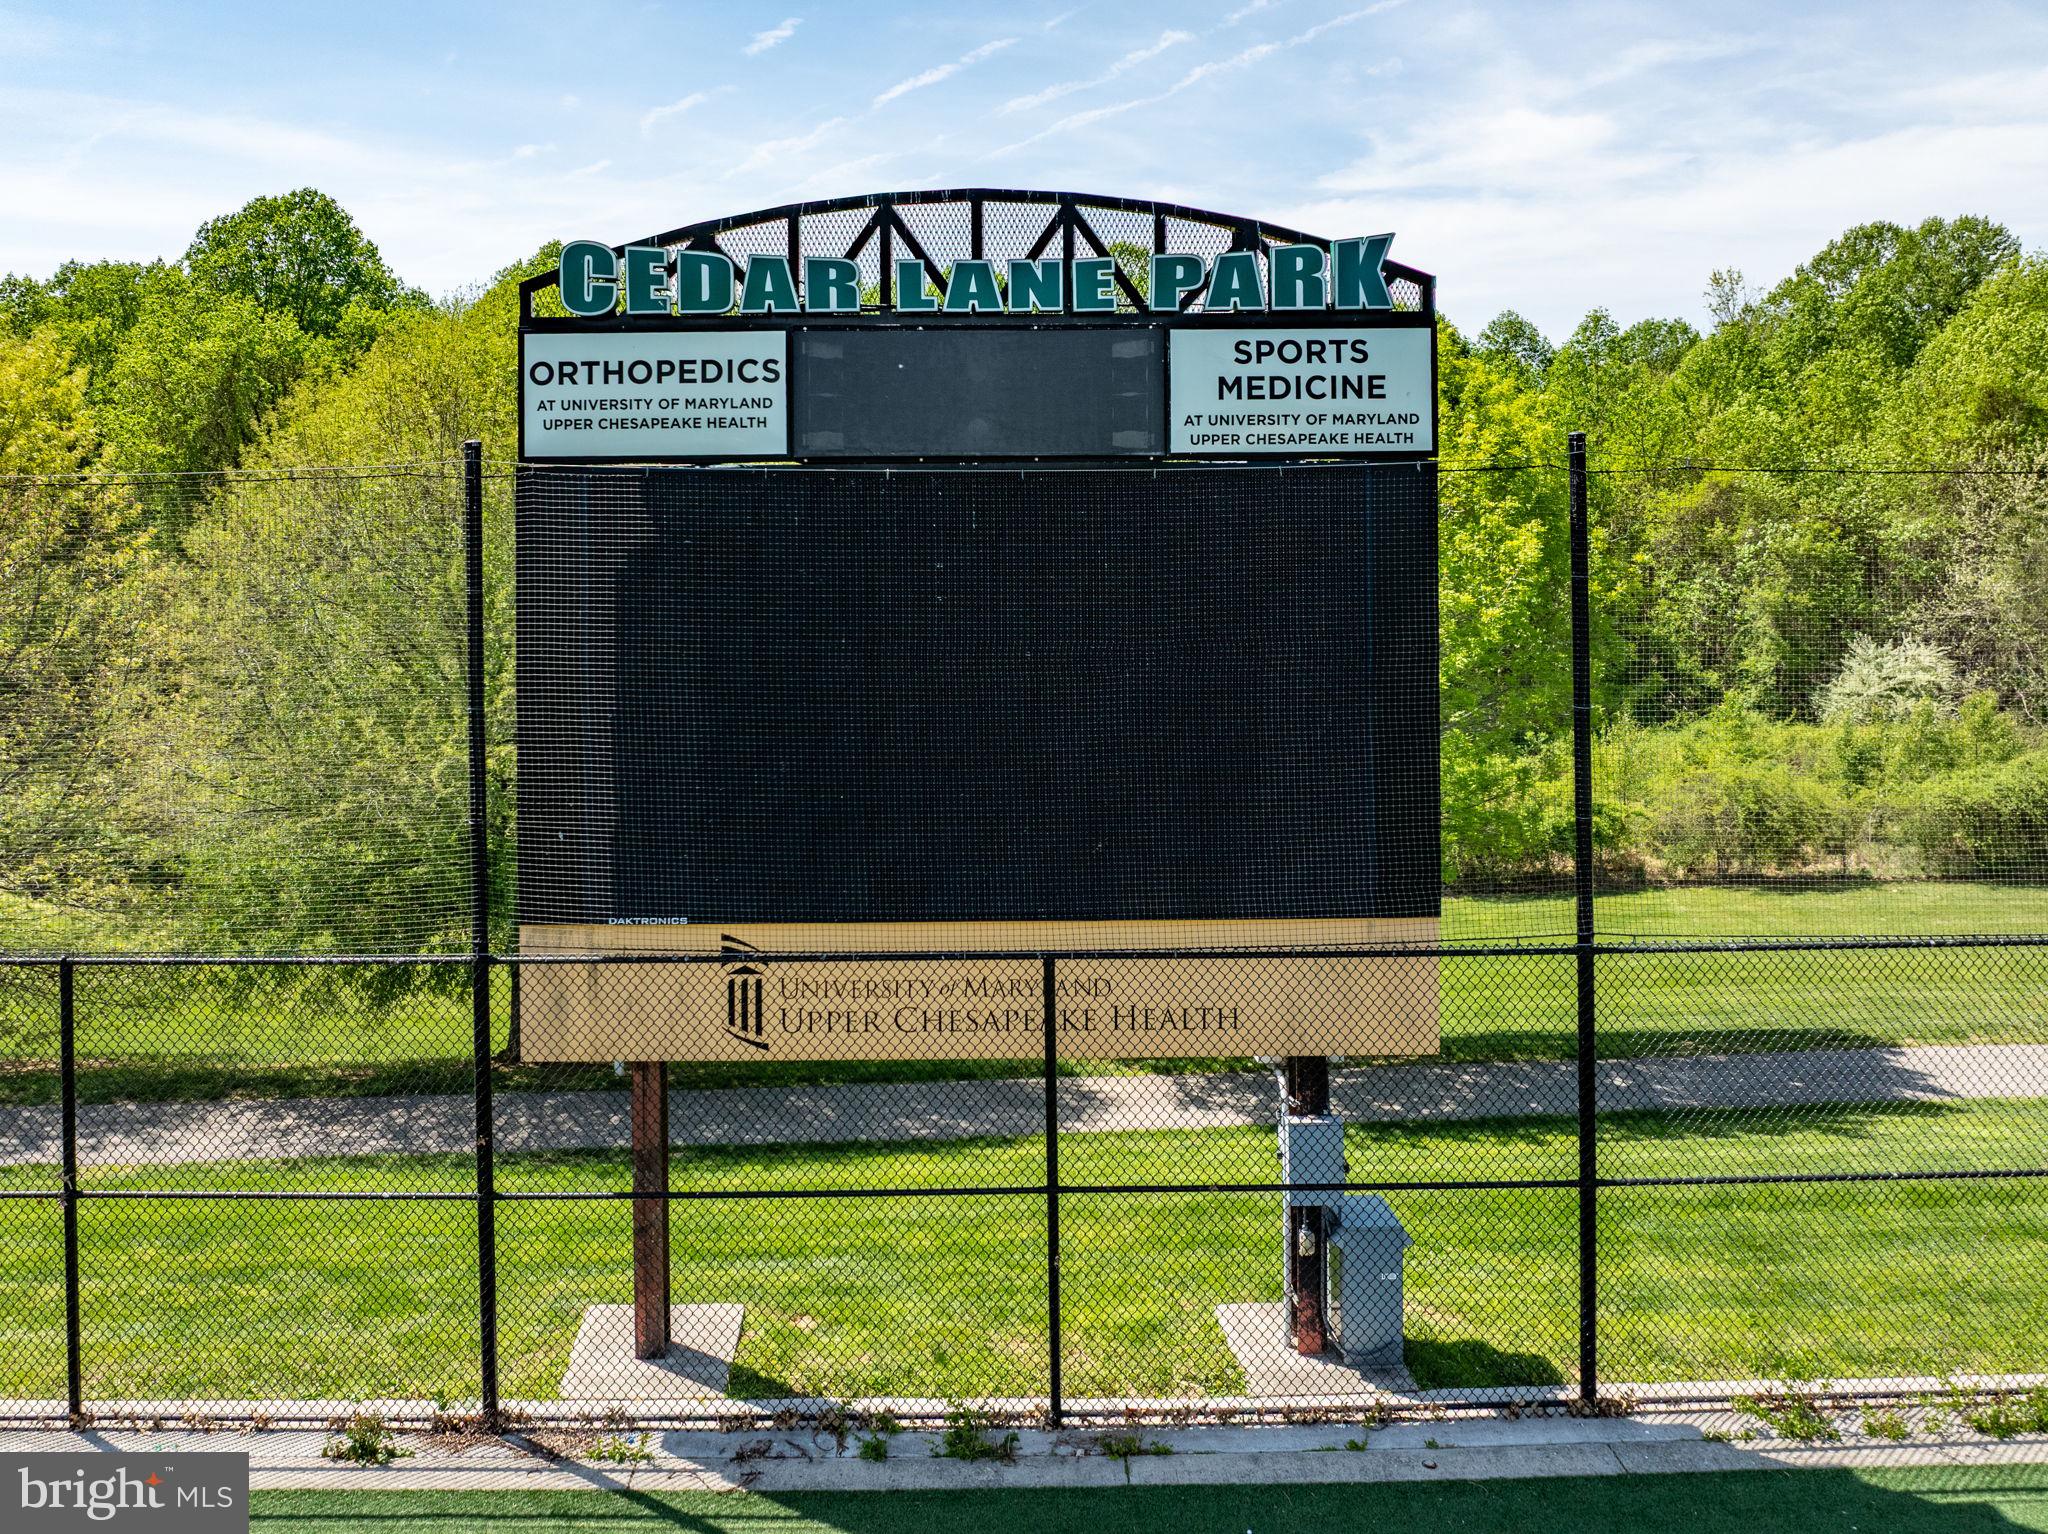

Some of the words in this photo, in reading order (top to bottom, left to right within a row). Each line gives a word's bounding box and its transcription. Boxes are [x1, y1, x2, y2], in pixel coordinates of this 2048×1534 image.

[560, 240, 861, 317] CEDAR
[896, 258, 1118, 313] LANE
[1149, 232, 1396, 312] PARK
[1233, 338, 1369, 365] SPORTS
[529, 358, 781, 386] ORTHOPEDICS
[1217, 374, 1387, 401] MEDICINE
[536, 399, 558, 412] AT
[561, 398, 653, 412] UNIVERSITY
[658, 398, 680, 411] OF
[684, 397, 773, 410] MARYLAND
[543, 417, 594, 430] UPPER
[598, 417, 702, 430] CHESAPEAKE
[706, 416, 767, 429] HEALTH
[1183, 414, 1203, 427] AT
[1207, 413, 1302, 427] UNIVERSITY
[1305, 413, 1328, 426] OF
[1332, 412, 1420, 426] MARYLAND
[1190, 433, 1241, 447] UPPER
[1245, 433, 1349, 446] CHESAPEAKE
[1354, 432, 1414, 445] HEALTH
[608, 917, 688, 925] DAKTRONICS
[964, 976, 1113, 998] MARYAND
